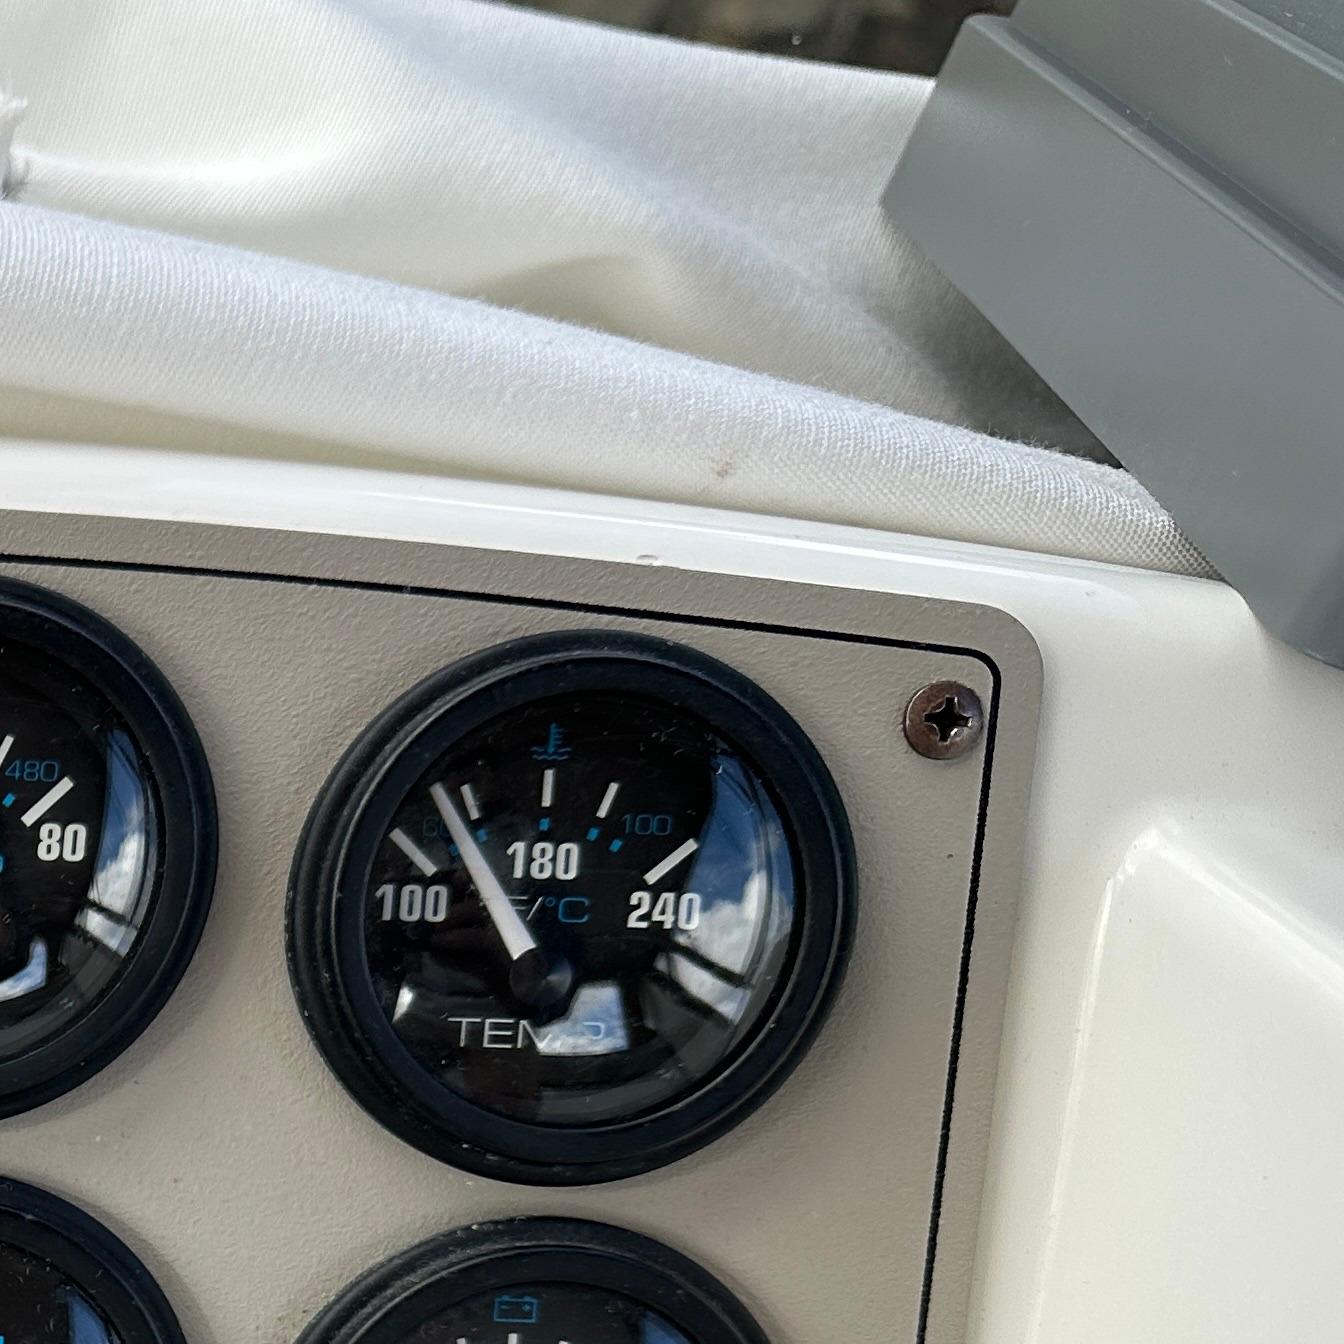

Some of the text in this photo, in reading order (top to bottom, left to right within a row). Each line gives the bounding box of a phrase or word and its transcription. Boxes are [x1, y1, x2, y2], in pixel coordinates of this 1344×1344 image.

[5, 760, 58, 782] 480
[37, 823, 87, 862] 80
[621, 814, 673, 836] 100
[506, 842, 580, 880] 180
[375, 884, 449, 922] 100
[626, 891, 702, 930] 240
